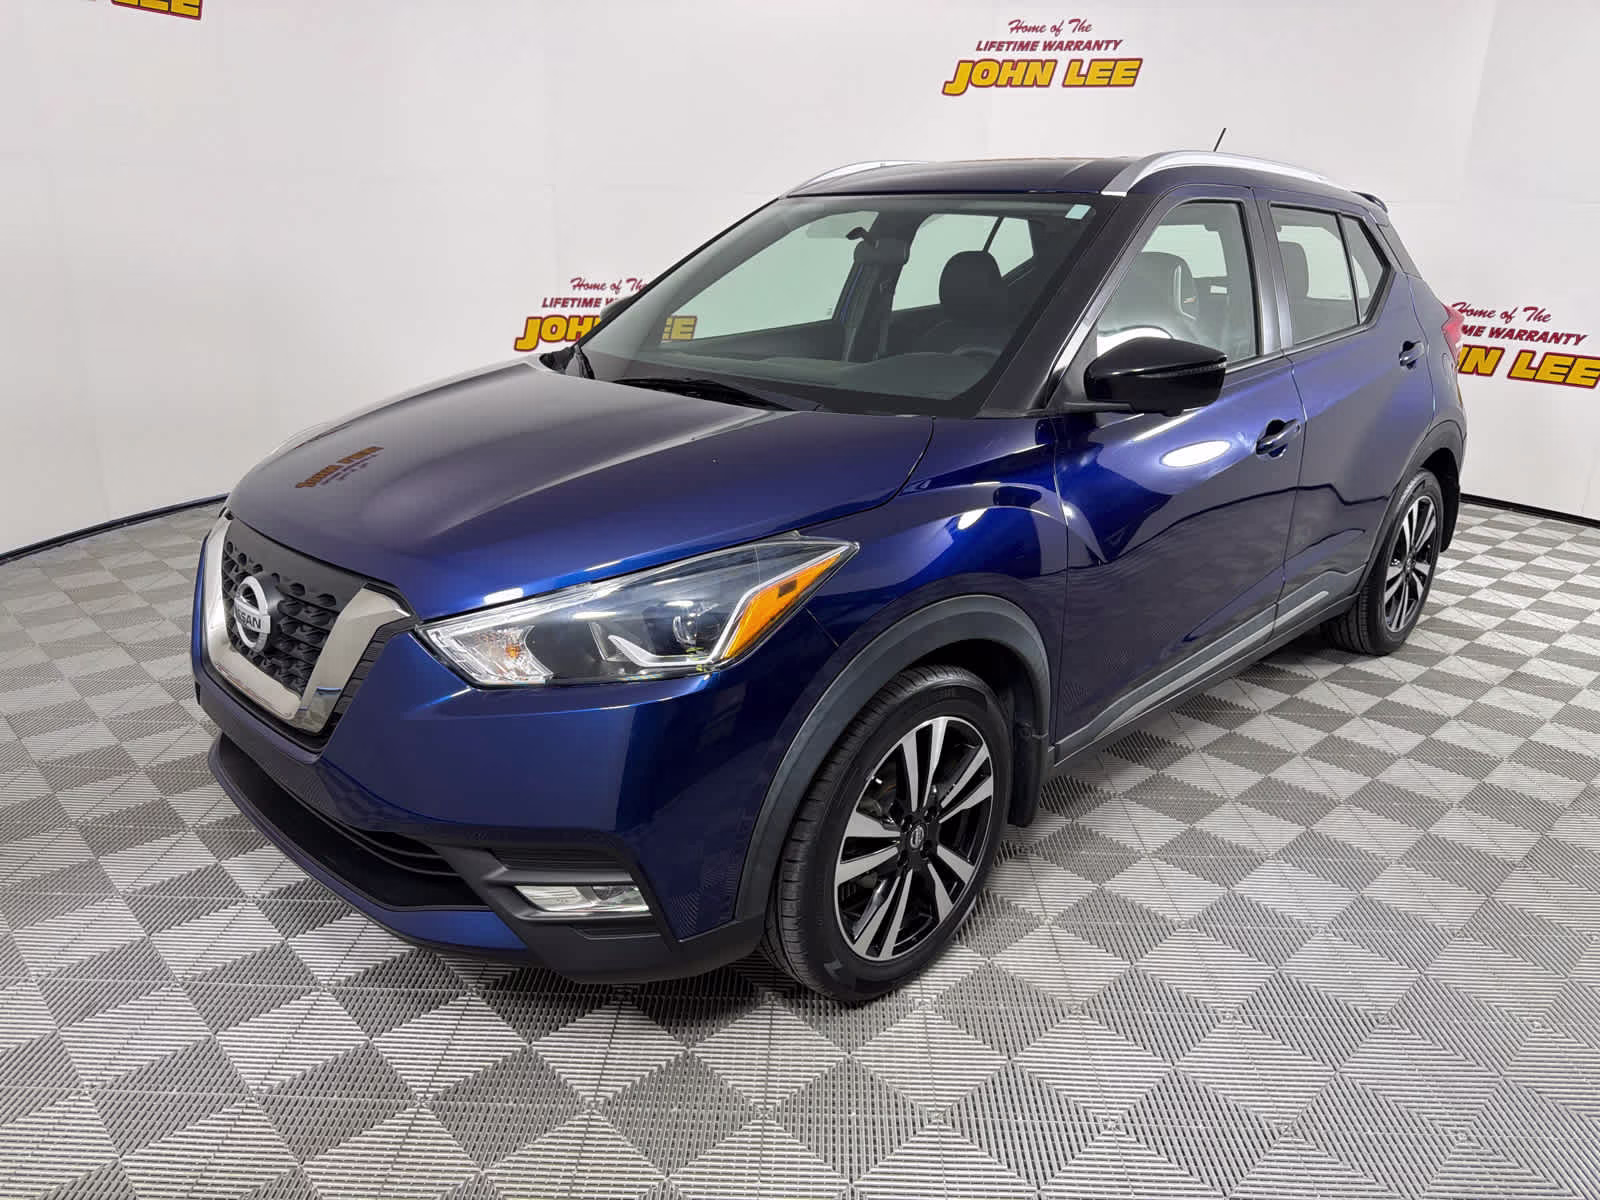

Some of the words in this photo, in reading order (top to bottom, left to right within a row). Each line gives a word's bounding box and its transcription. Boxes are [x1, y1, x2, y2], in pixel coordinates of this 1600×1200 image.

[1008, 19, 1047, 34] Home
[1050, 20, 1064, 37] of
[1068, 18, 1093, 34] The
[975, 40, 1040, 52] LIFETIME
[1042, 39, 1124, 51] WARRANTY
[942, 58, 1058, 96] JOHN
[1062, 58, 1143, 88] LEE
[570, 277, 608, 292] Home
[609, 279, 622, 295] of
[542, 297, 602, 308] LIFETIME
[1499, 307, 1518, 324] of
[1522, 306, 1552, 323] The
[514, 314, 601, 351] JOH
[1488, 327, 1588, 346] WARRANTY
[1507, 349, 1600, 389] LEE
